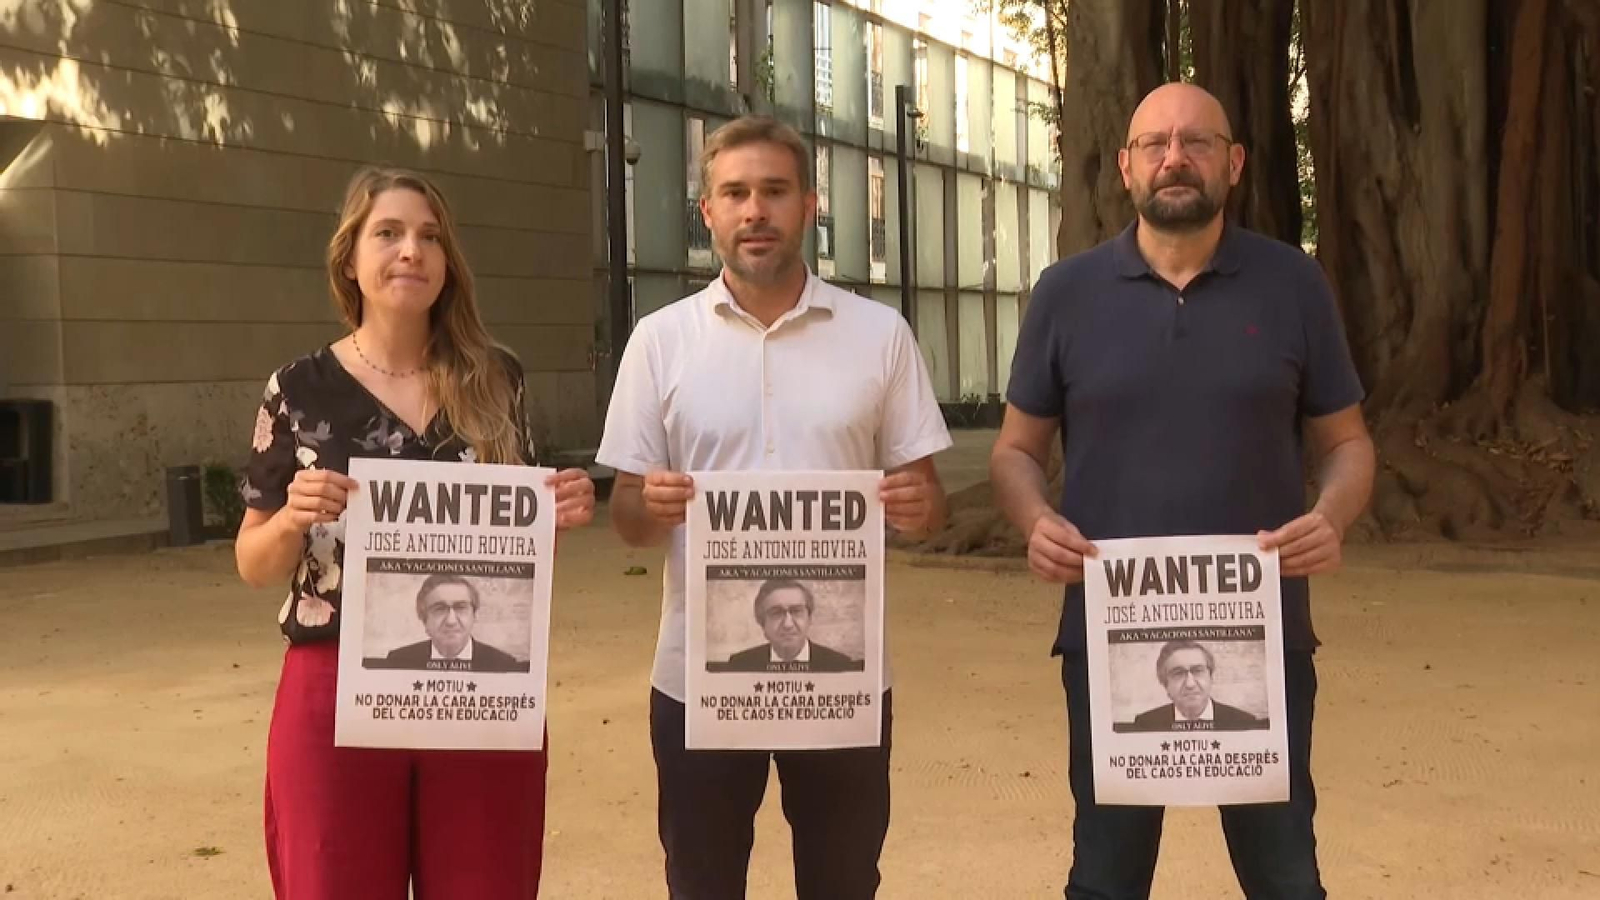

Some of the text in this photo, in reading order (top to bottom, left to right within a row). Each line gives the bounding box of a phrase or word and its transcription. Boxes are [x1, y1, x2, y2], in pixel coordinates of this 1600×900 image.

[369, 480, 538, 527] WANTED
[705, 490, 867, 531] WANTED
[365, 530, 537, 556] JOSÉ ANTONIO ROVIRA
[703, 536, 867, 559] JOSÉ ANTONIO ROVIRA
[379, 561, 401, 571] AKA
[719, 568, 738, 577] AKA
[1103, 553, 1262, 597] WANTED
[1104, 601, 1265, 624] JOSÉ ANTONIO ROVIRA
[1119, 632, 1139, 641] AKA
[426, 661, 448, 669] ONLY
[426, 680, 464, 693] MOTIU
[767, 681, 802, 693] MOTIU
[355, 694, 372, 706] NO
[376, 694, 419, 707] DONAR
[423, 695, 439, 707] LA
[442, 696, 476, 708] CARA
[701, 696, 717, 708] NO
[721, 695, 761, 708] DONAR
[764, 695, 779, 707] LA
[782, 695, 814, 707] CARA
[372, 707, 395, 720] DEL
[399, 708, 433, 720] CAOS
[436, 708, 453, 720] EN
[717, 708, 739, 720] DEL
[742, 708, 774, 720] CAOS
[777, 707, 793, 720] EN
[1173, 740, 1208, 751] MOTIU
[1109, 756, 1126, 768] NO
[1129, 754, 1169, 767] DONAR
[1172, 754, 1186, 765] LA
[1189, 753, 1222, 765] CARA
[1126, 767, 1147, 779] DEL
[1151, 766, 1183, 778] CAOS
[1186, 766, 1200, 777] EN
